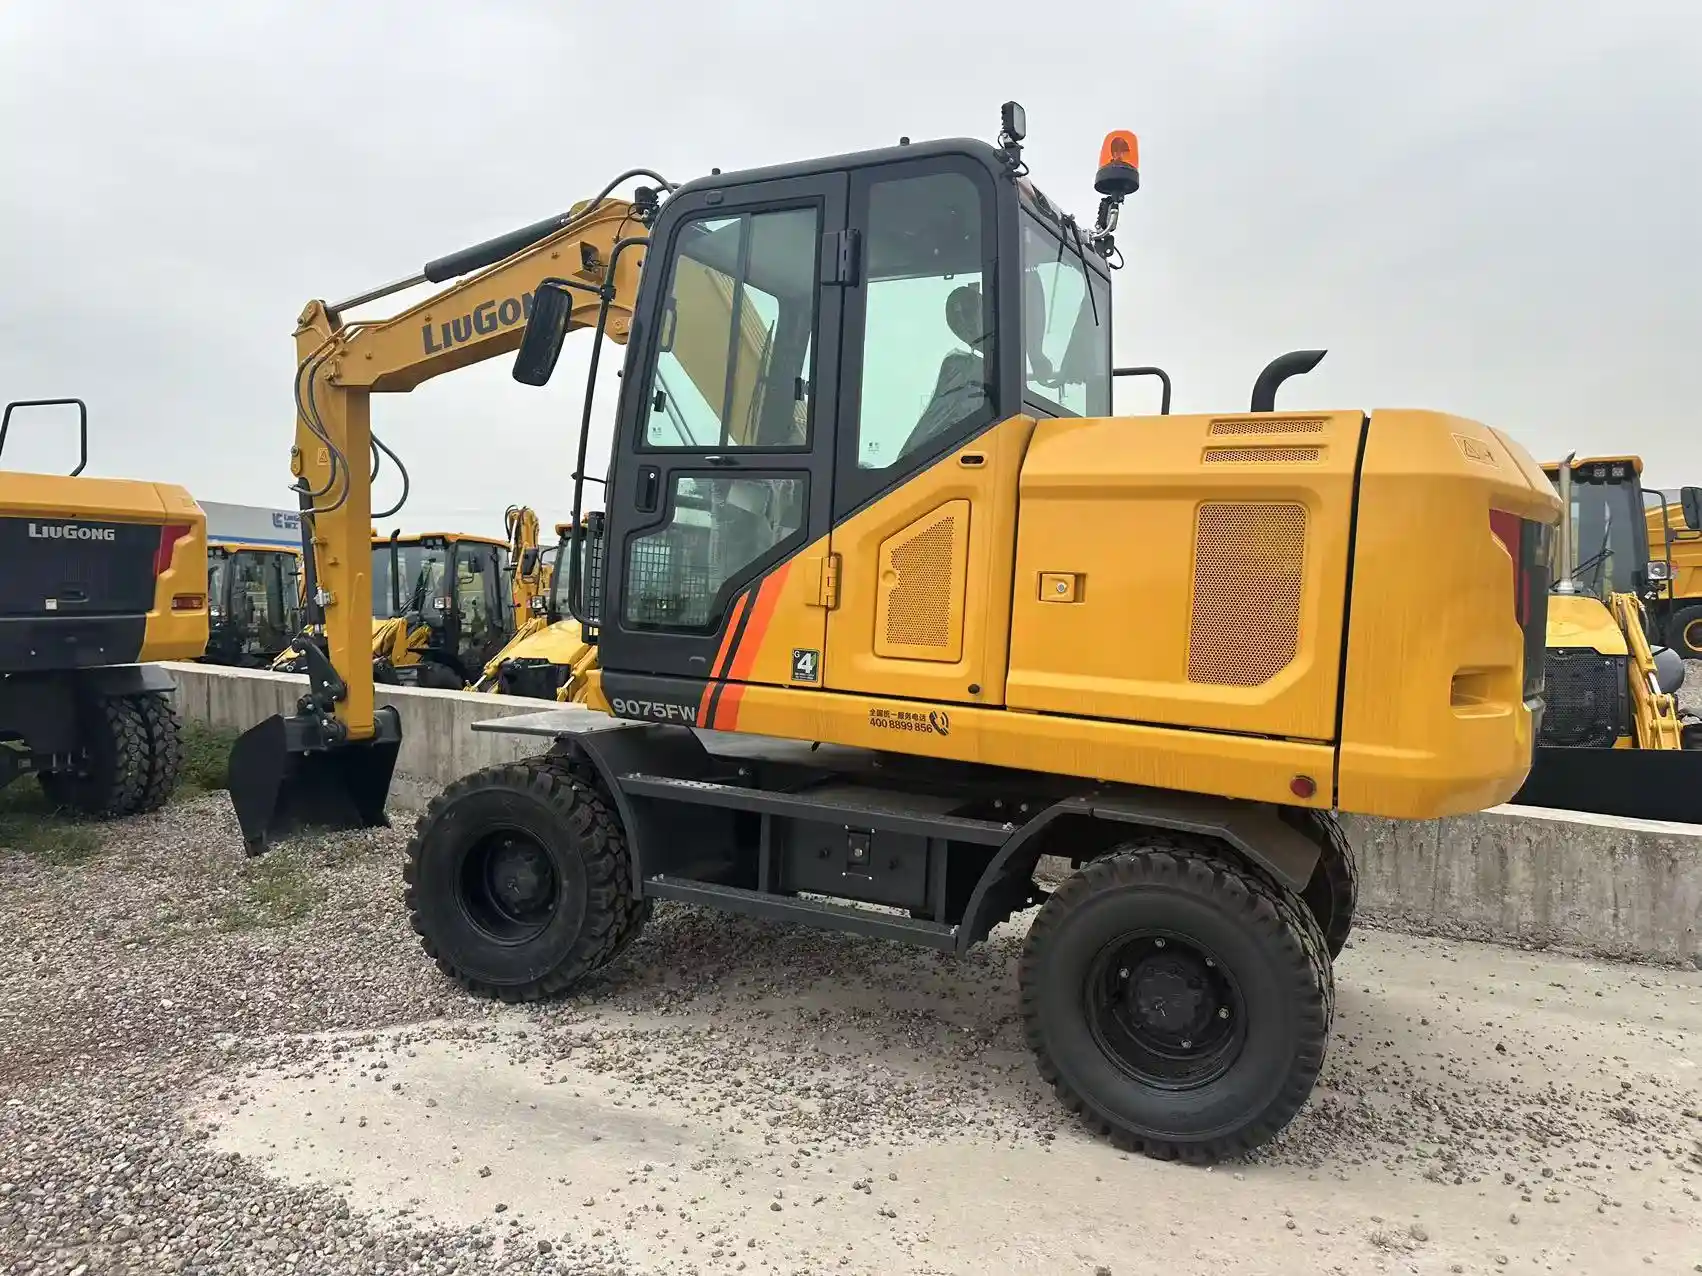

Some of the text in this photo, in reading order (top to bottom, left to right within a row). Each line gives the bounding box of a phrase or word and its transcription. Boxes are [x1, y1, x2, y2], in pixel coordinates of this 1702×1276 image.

[797, 652, 813, 674] 4
[612, 698, 696, 722] 9075FW
[869, 708, 926, 722] 全国统一服务电话
[869, 717, 933, 734] 400 8899 856
